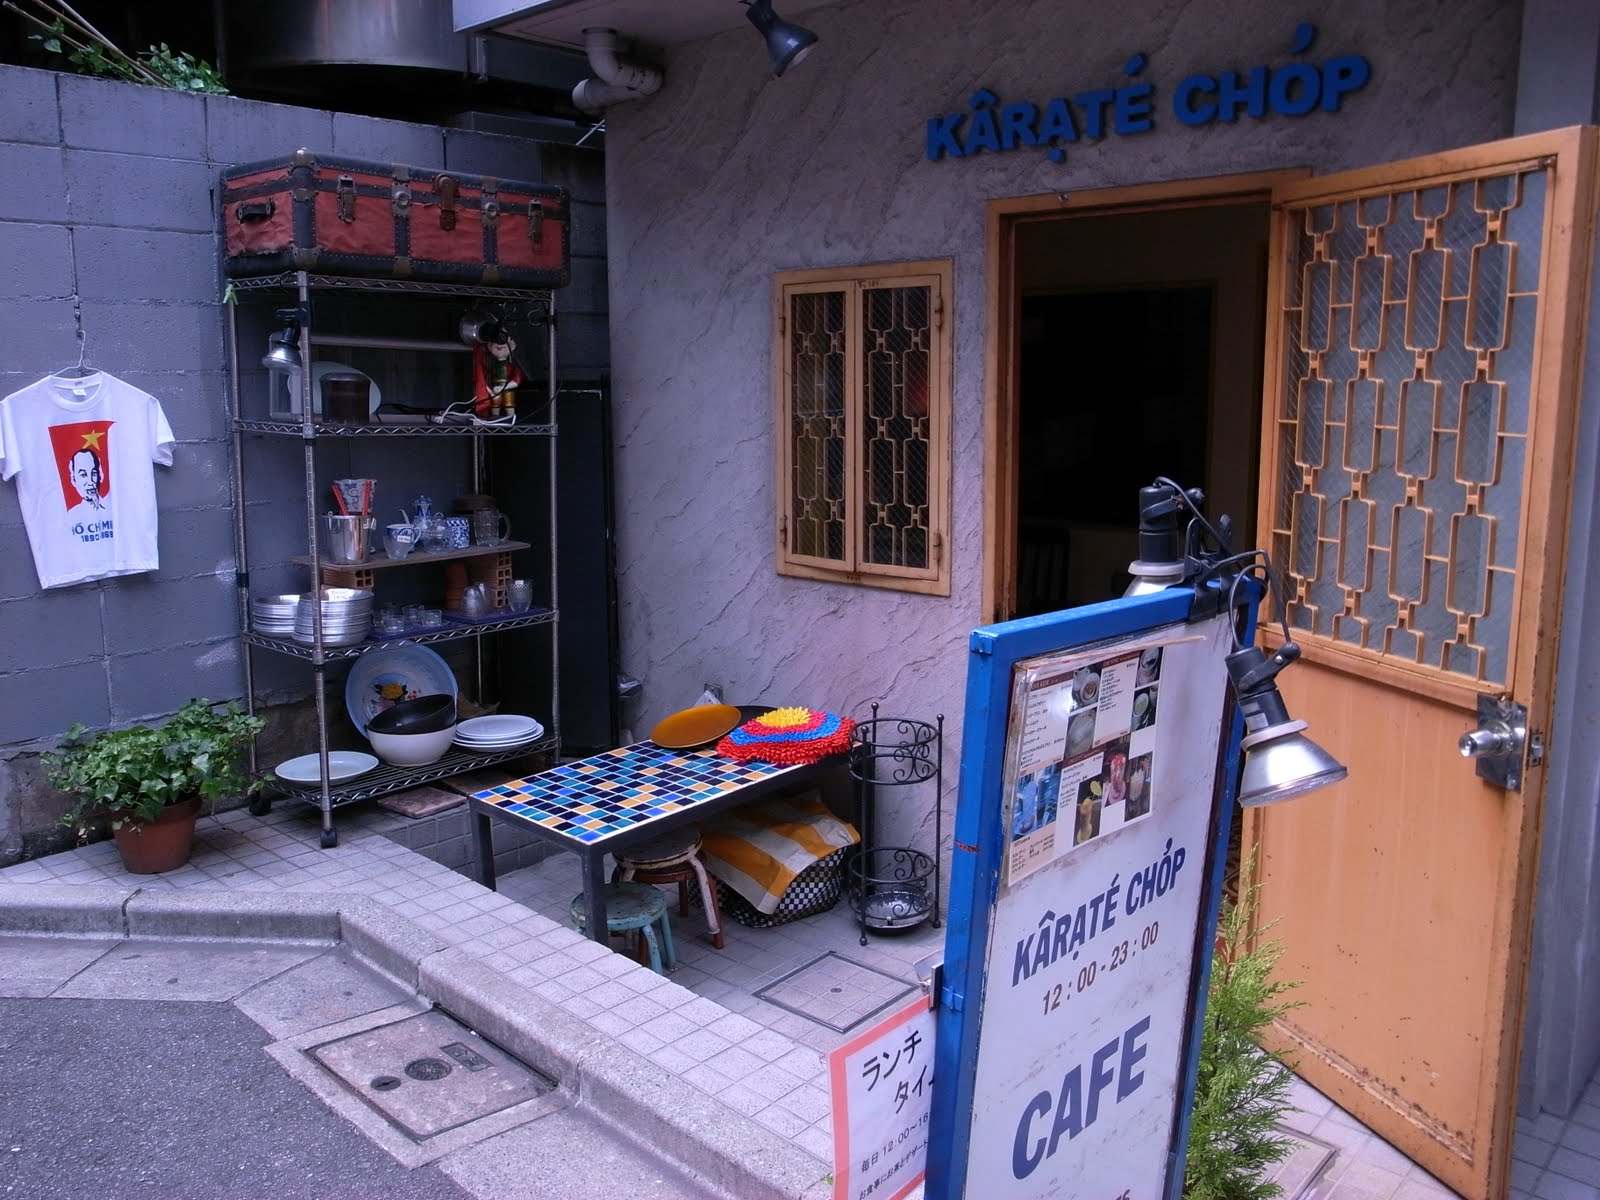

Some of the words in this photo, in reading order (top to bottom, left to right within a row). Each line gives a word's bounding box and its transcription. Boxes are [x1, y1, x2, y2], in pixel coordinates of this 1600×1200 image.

[862, 1029, 922, 1092] ランチ
[894, 1065, 934, 1114] タイ
[1011, 1015, 1152, 1180] CAFE
